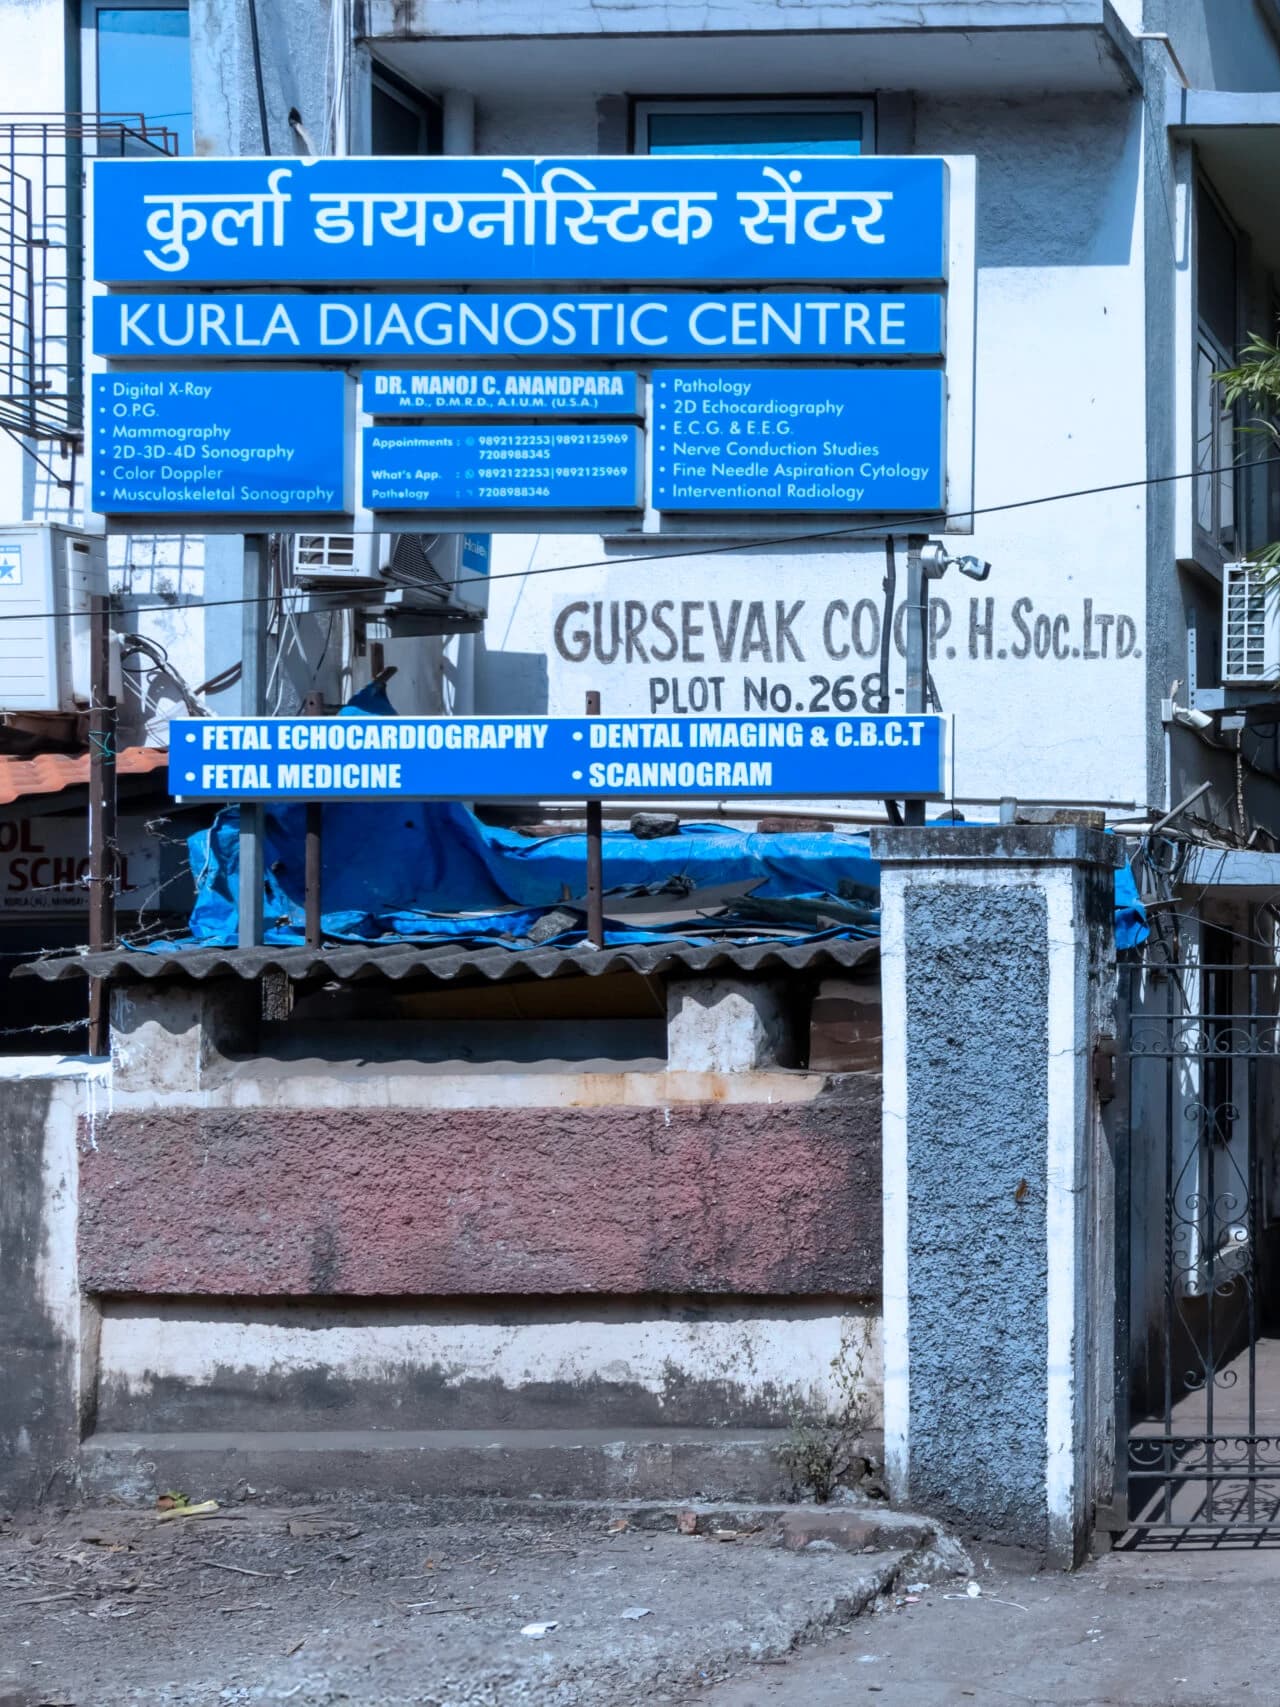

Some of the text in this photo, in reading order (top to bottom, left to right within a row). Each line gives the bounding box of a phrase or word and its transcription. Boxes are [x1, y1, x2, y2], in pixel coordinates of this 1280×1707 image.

[144, 166, 894, 273] कुर्ला डायग्नोस्टिक सेंटर
[120, 301, 906, 347] KURLA DIAGNOSTIC CENTRE
[113, 381, 213, 400] Digital X-Ray
[375, 375, 624, 396] DR. MANOJ C. ANANDPARA
[673, 378, 752, 397] Pathology
[113, 403, 160, 418] O.P.G.
[673, 400, 845, 417] 2D Echocardiography
[113, 424, 231, 441] Mammography
[673, 420, 794, 435] E.C.G. & E.E.G.
[113, 443, 295, 462] 2D-3D-4D Sonography
[371, 437, 453, 450] Appointments
[673, 441, 880, 456] Nerve Conduction Studies
[478, 449, 551, 460] 7208988345
[113, 465, 223, 482] Color Doppler
[673, 462, 930, 481] Fine Needle Aspiration Cytology
[113, 485, 335, 504] Musculoskeletal Sonography
[371, 487, 430, 500] Pathology
[673, 483, 865, 502] Interventional Radiology
[553, 599, 807, 665] GURSEVAK
[649, 676, 726, 714] PLOT
[202, 723, 549, 751] FETAL ECHOCARDIOGRAPHY
[589, 721, 926, 749] DENTAL IMAGING & C.B.C.T
[202, 763, 402, 790] FETAL MEDICINE
[588, 761, 773, 788] SCANNOGRAM
[8, 854, 138, 892] SCHOL
